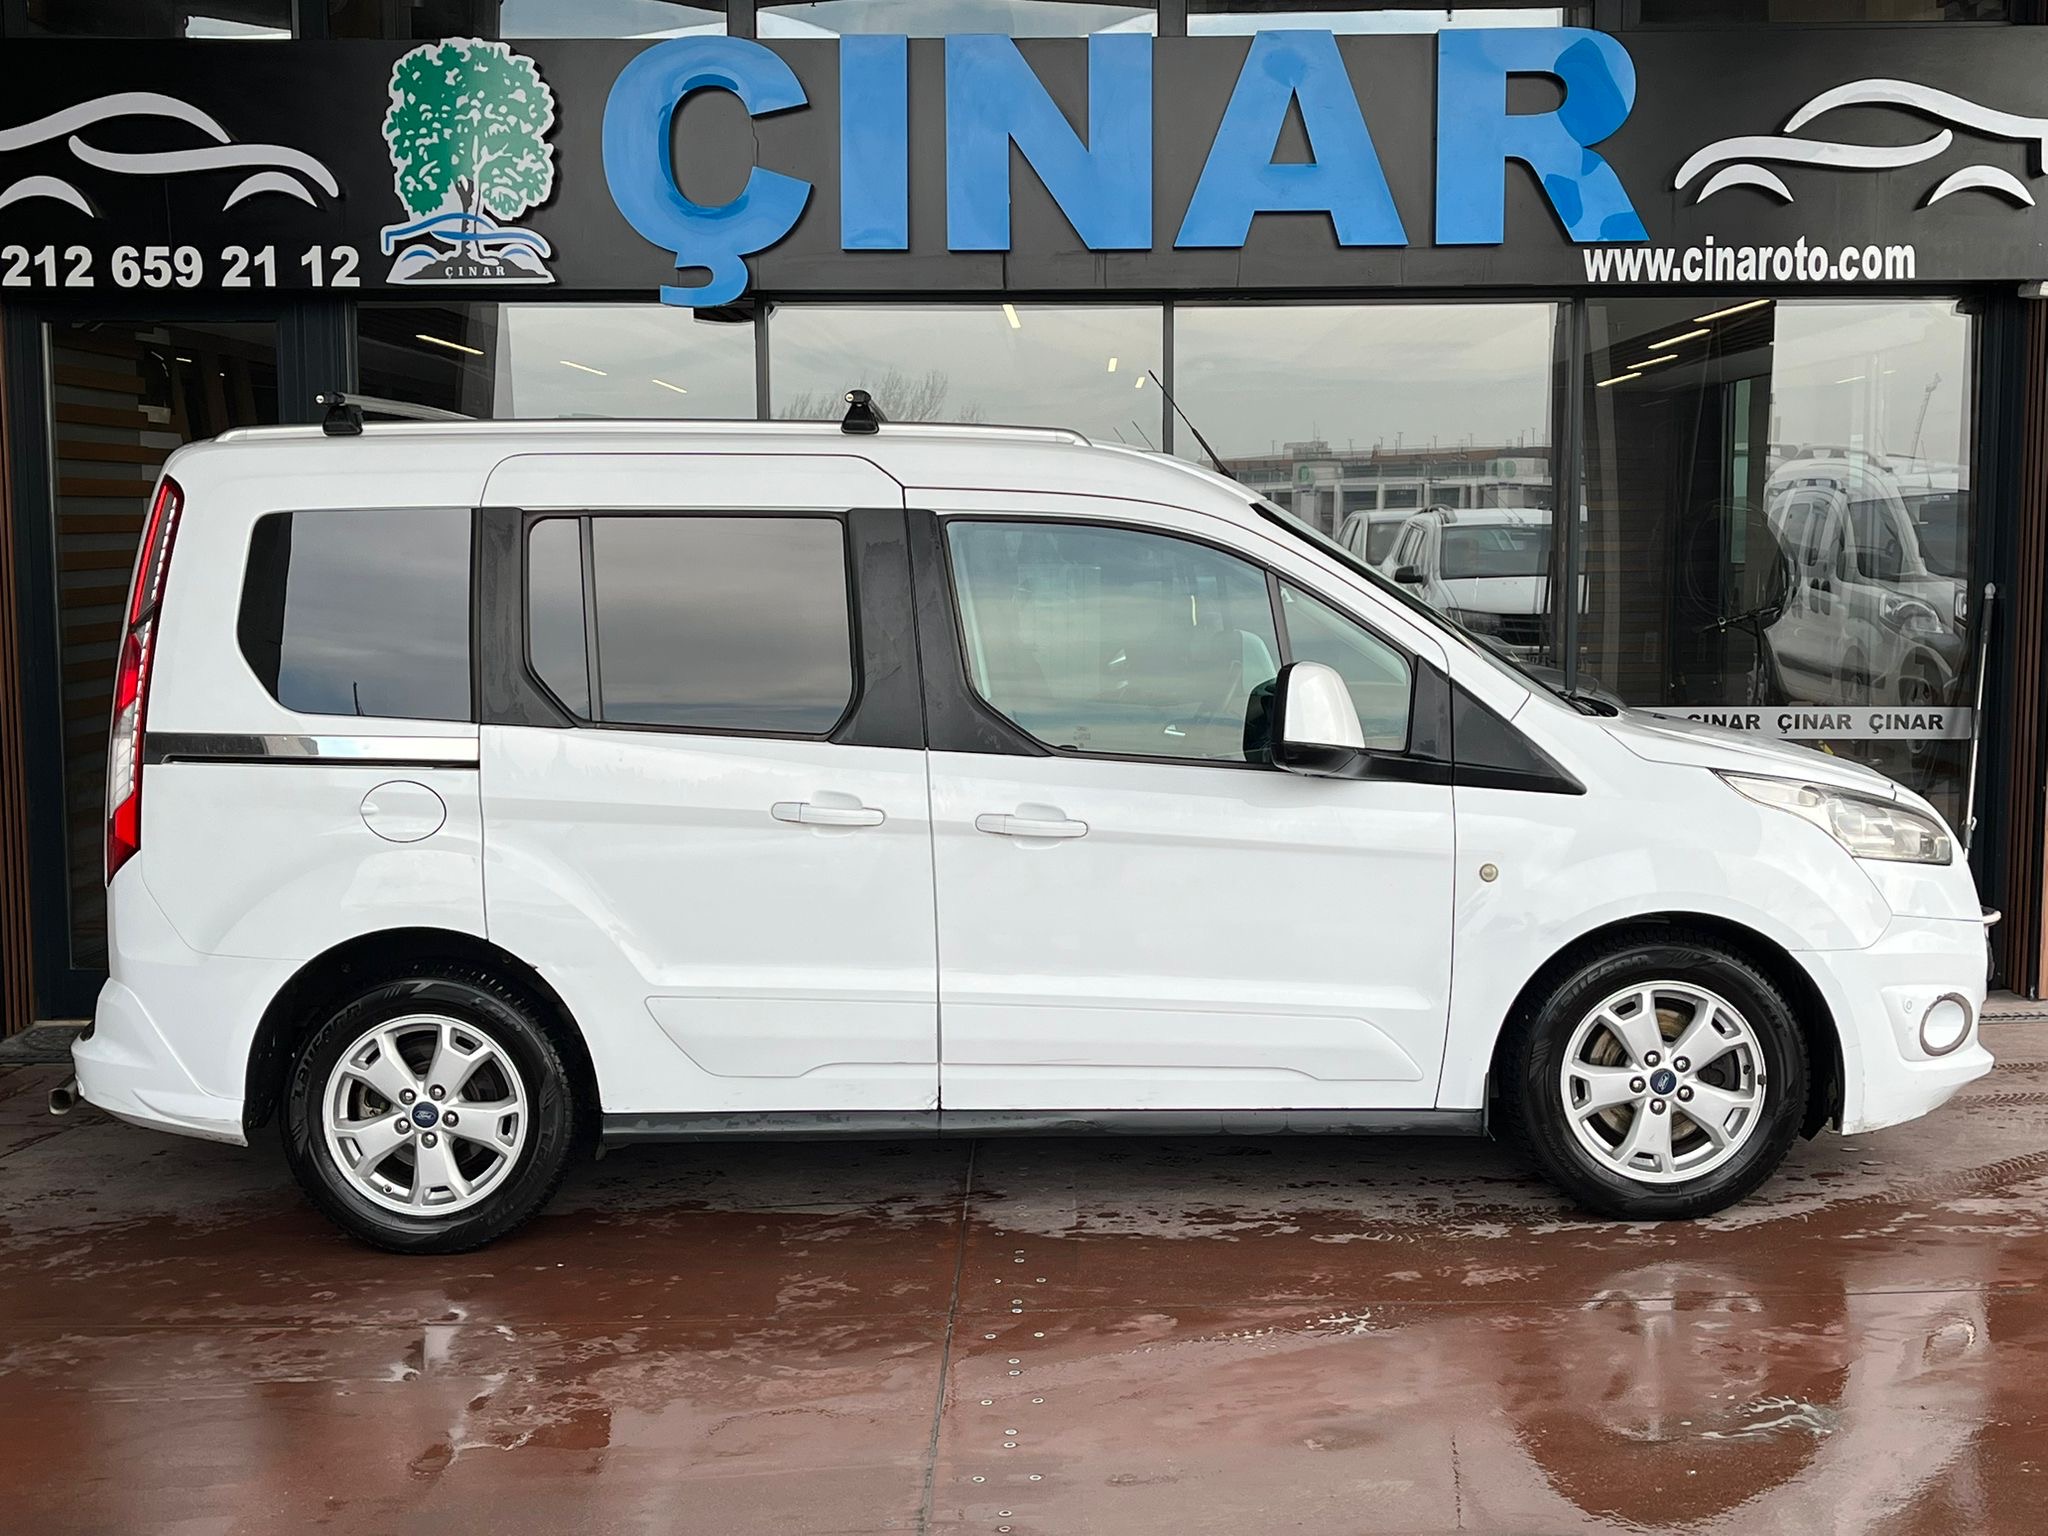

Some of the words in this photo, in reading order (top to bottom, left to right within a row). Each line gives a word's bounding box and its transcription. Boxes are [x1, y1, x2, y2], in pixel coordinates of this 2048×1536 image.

[602, 26, 1651, 309] ÇINAR
[1, 245, 95, 288] 212
[111, 245, 204, 288] 659
[221, 245, 277, 288] 21
[300, 245, 361, 288] 12
[444, 266, 507, 279] ÇINAR
[1583, 235, 1917, 283] www.cinaroto.com
[1777, 713, 1853, 734] ÇINAR
[1868, 713, 1944, 734] ÇINAR
